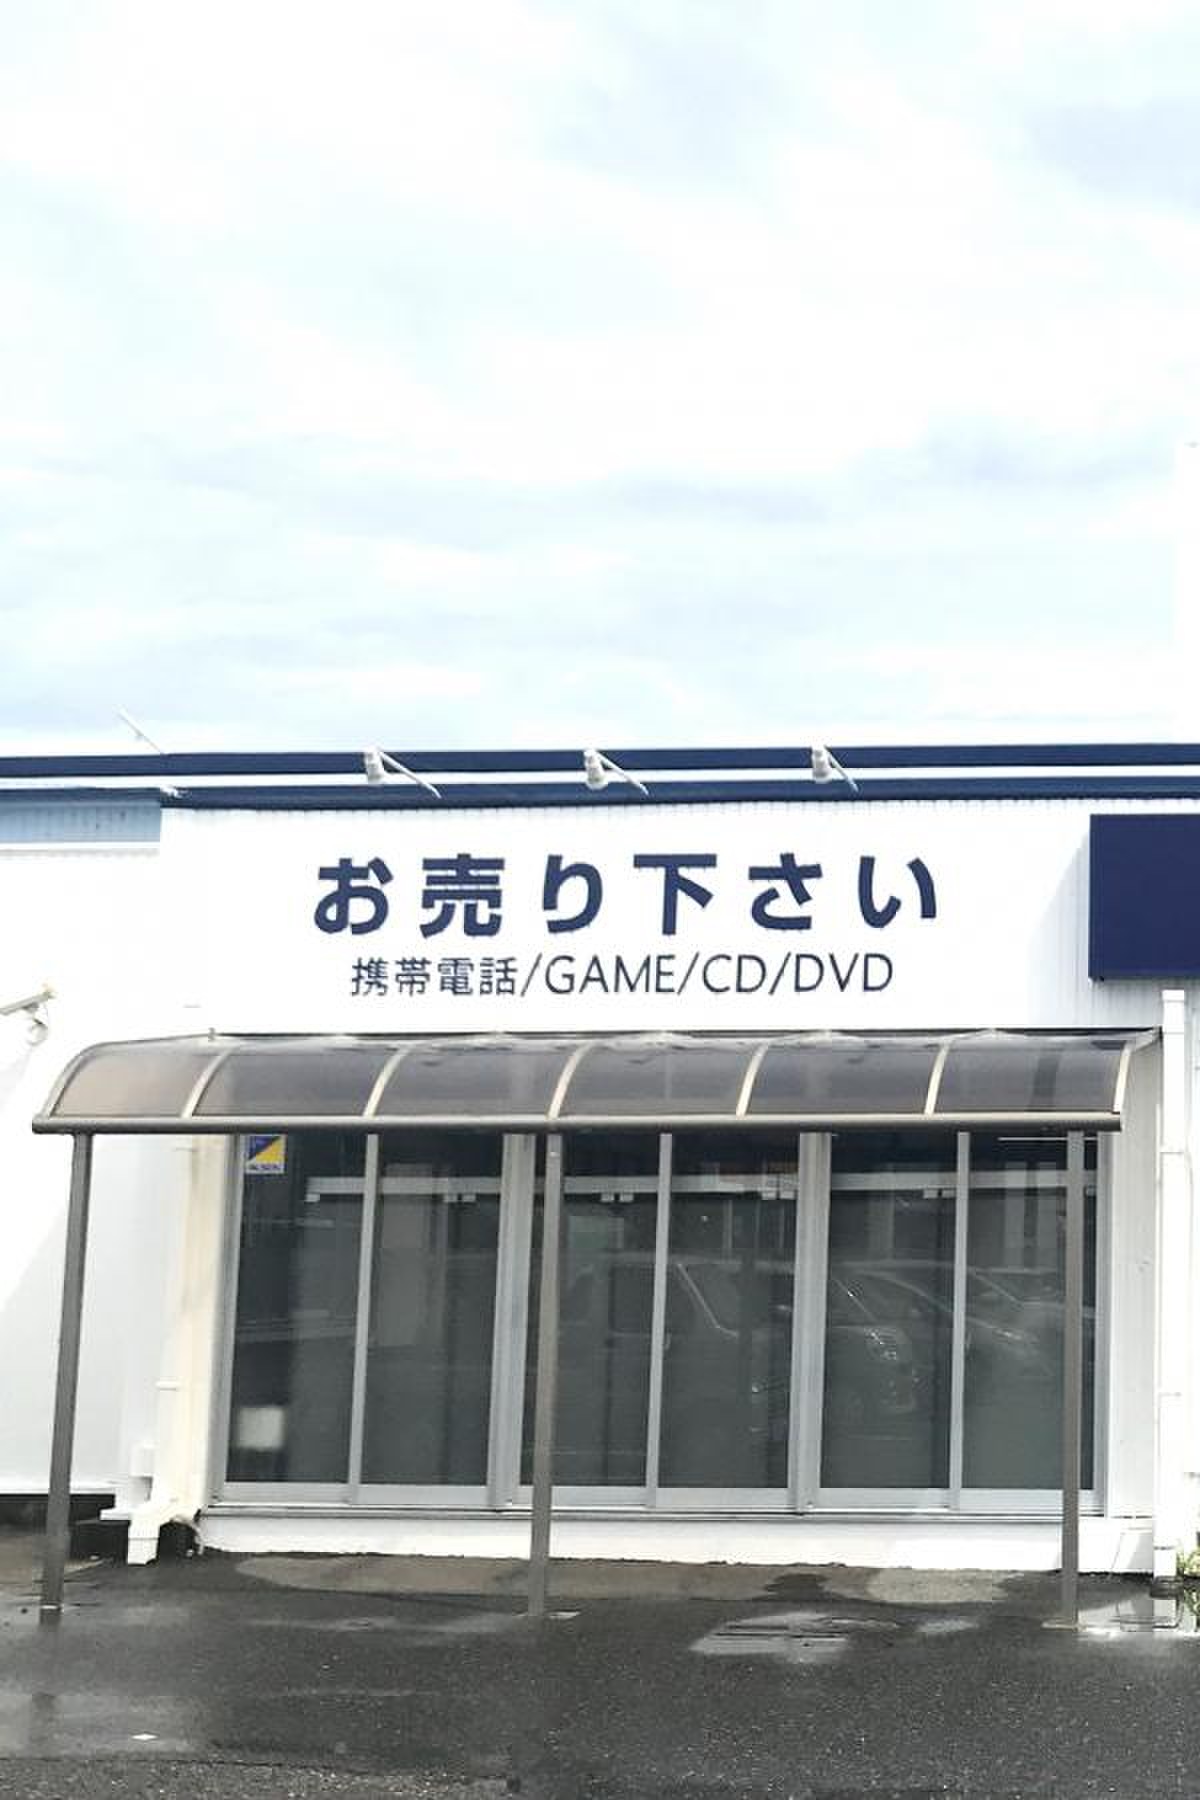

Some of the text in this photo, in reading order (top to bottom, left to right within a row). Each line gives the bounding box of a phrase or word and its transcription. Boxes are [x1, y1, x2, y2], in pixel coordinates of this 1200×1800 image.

[313, 852, 937, 938] お売り下さい
